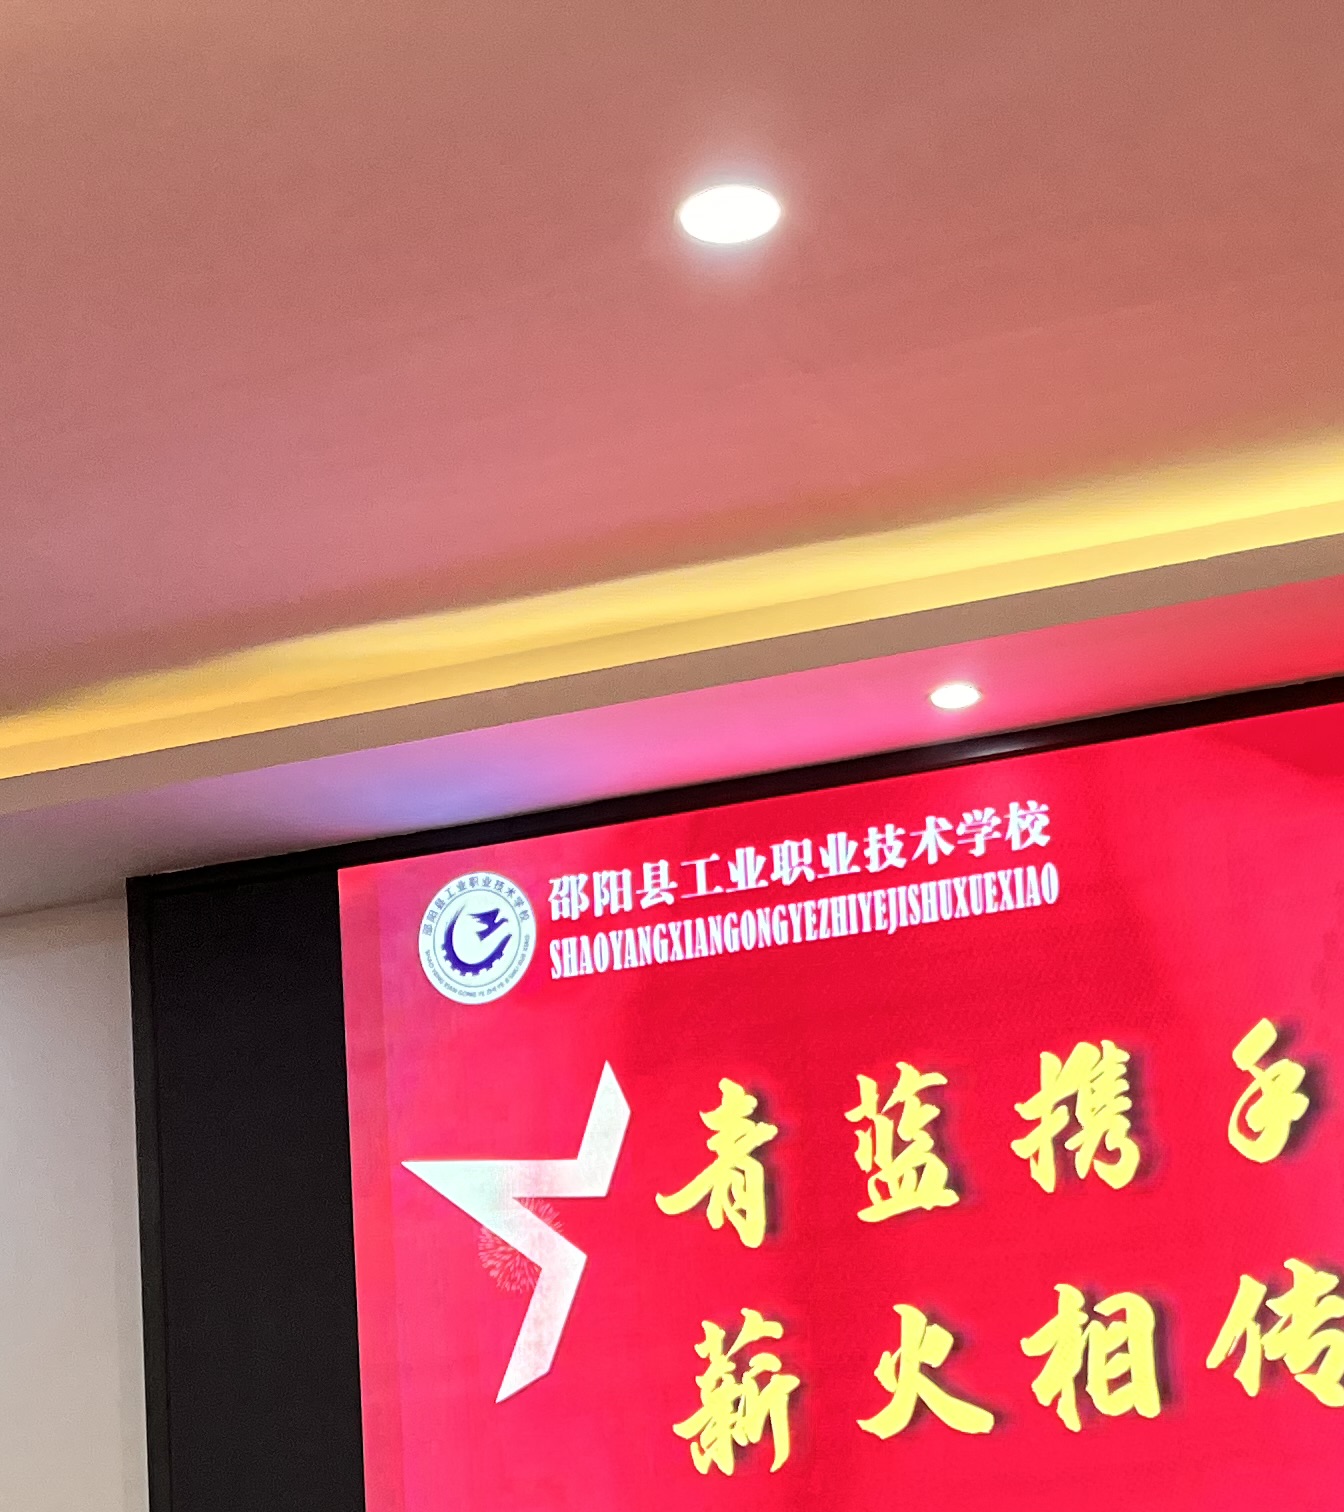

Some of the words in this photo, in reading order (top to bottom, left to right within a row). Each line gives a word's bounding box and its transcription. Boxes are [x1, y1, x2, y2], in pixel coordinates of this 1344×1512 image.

[548, 800, 1051, 921] 邵阳县工业职业技术学校
[549, 862, 1059, 979] SHAOYANGXIANGONGYEZHIYEJISHUXUEXIAO
[656, 1018, 1311, 1248] 青蓝携手
